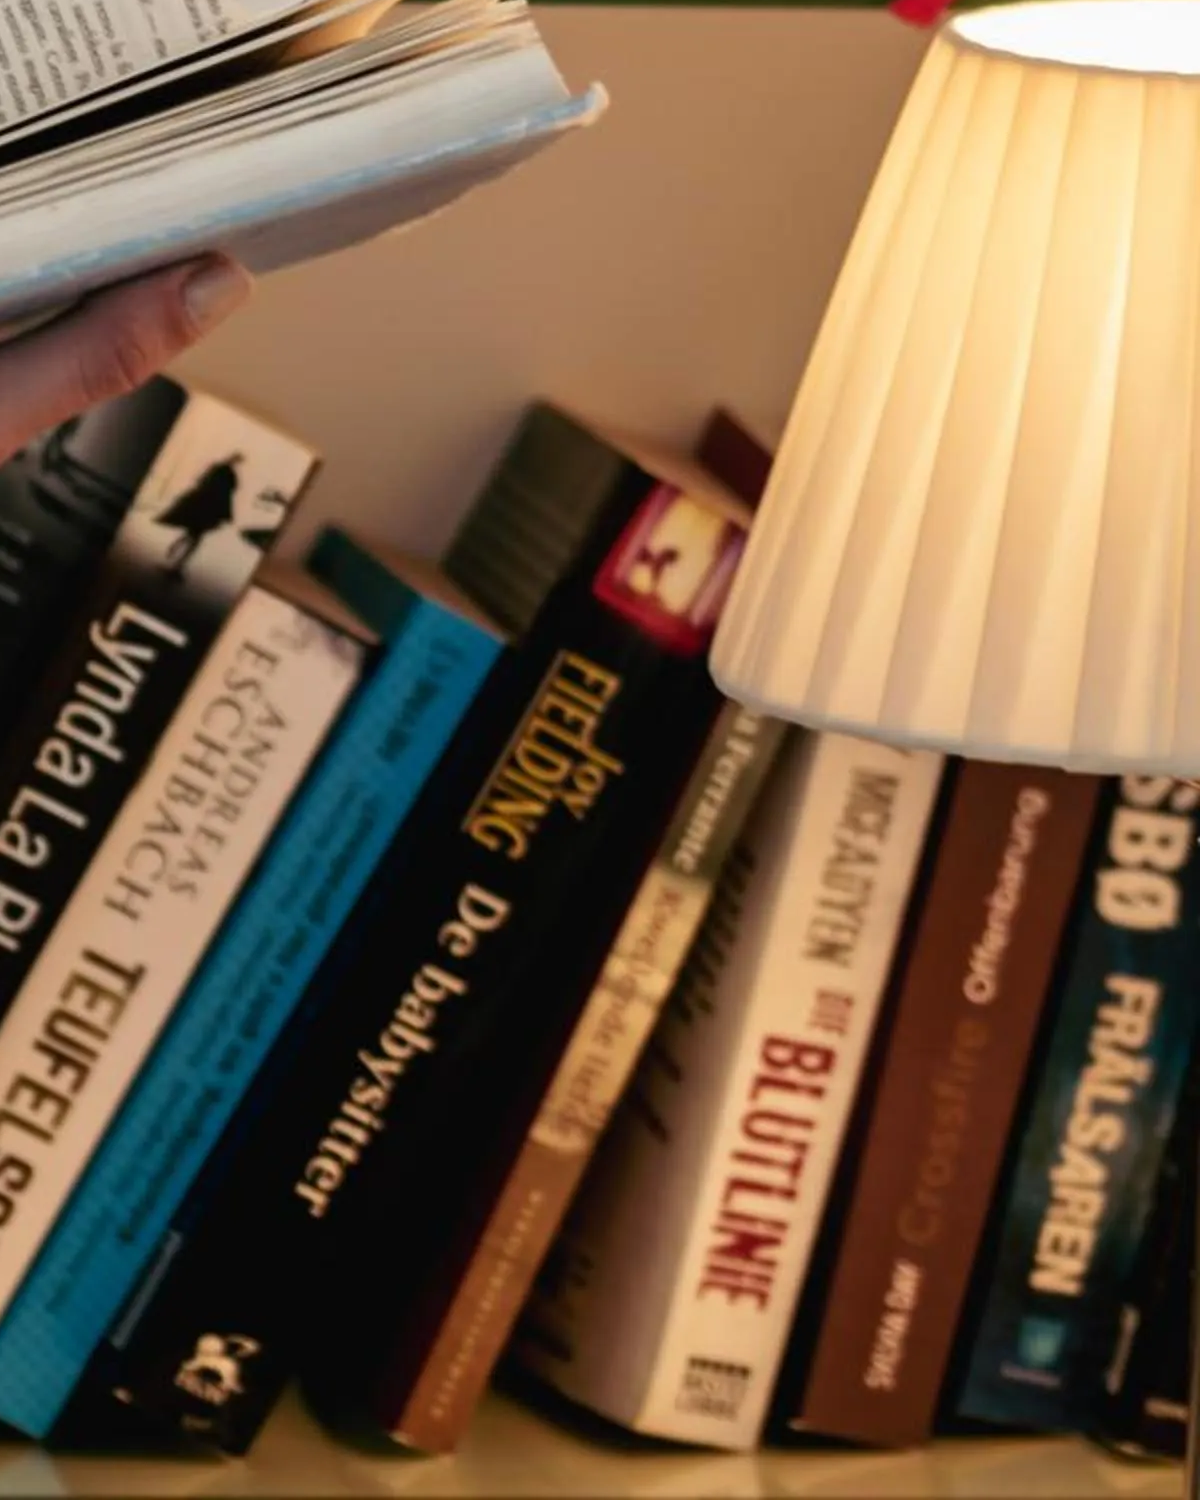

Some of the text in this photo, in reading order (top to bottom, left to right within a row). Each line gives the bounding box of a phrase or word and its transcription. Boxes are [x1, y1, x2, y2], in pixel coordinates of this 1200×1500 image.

[30, 591, 188, 803] Lynda
[100, 636, 281, 925] ESCHBACH
[164, 701, 293, 905] ANDREAS
[461, 648, 622, 866] FIELDING
[549, 741, 626, 821] Joy
[670, 732, 757, 875] Ferrante
[432, 880, 511, 965] De
[959, 782, 1053, 1008] Offenbarung
[285, 955, 465, 1223] babysitter
[697, 1029, 837, 1316] BLUTLINIE
[896, 1015, 989, 1249] Crossfire
[1025, 967, 1162, 1303] FRÄLSAREN
